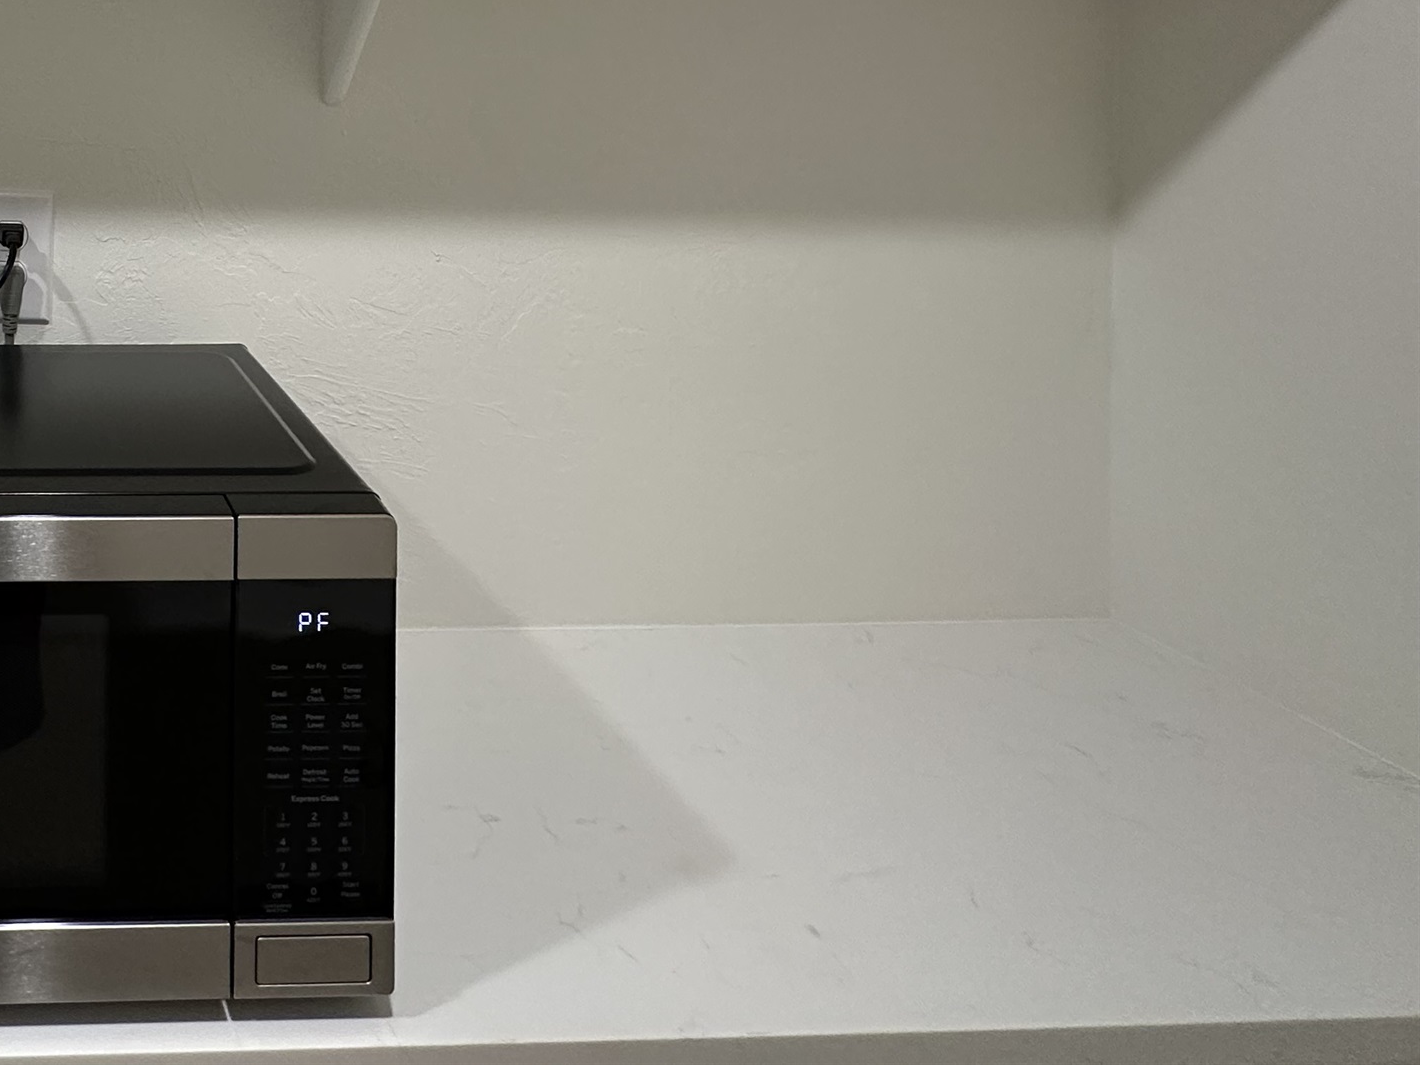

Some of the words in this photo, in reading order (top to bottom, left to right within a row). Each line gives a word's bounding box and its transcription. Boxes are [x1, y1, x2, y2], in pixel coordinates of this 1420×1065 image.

[298, 611, 330, 633] PF
[311, 811, 318, 821] 2
[342, 811, 349, 821] 3
